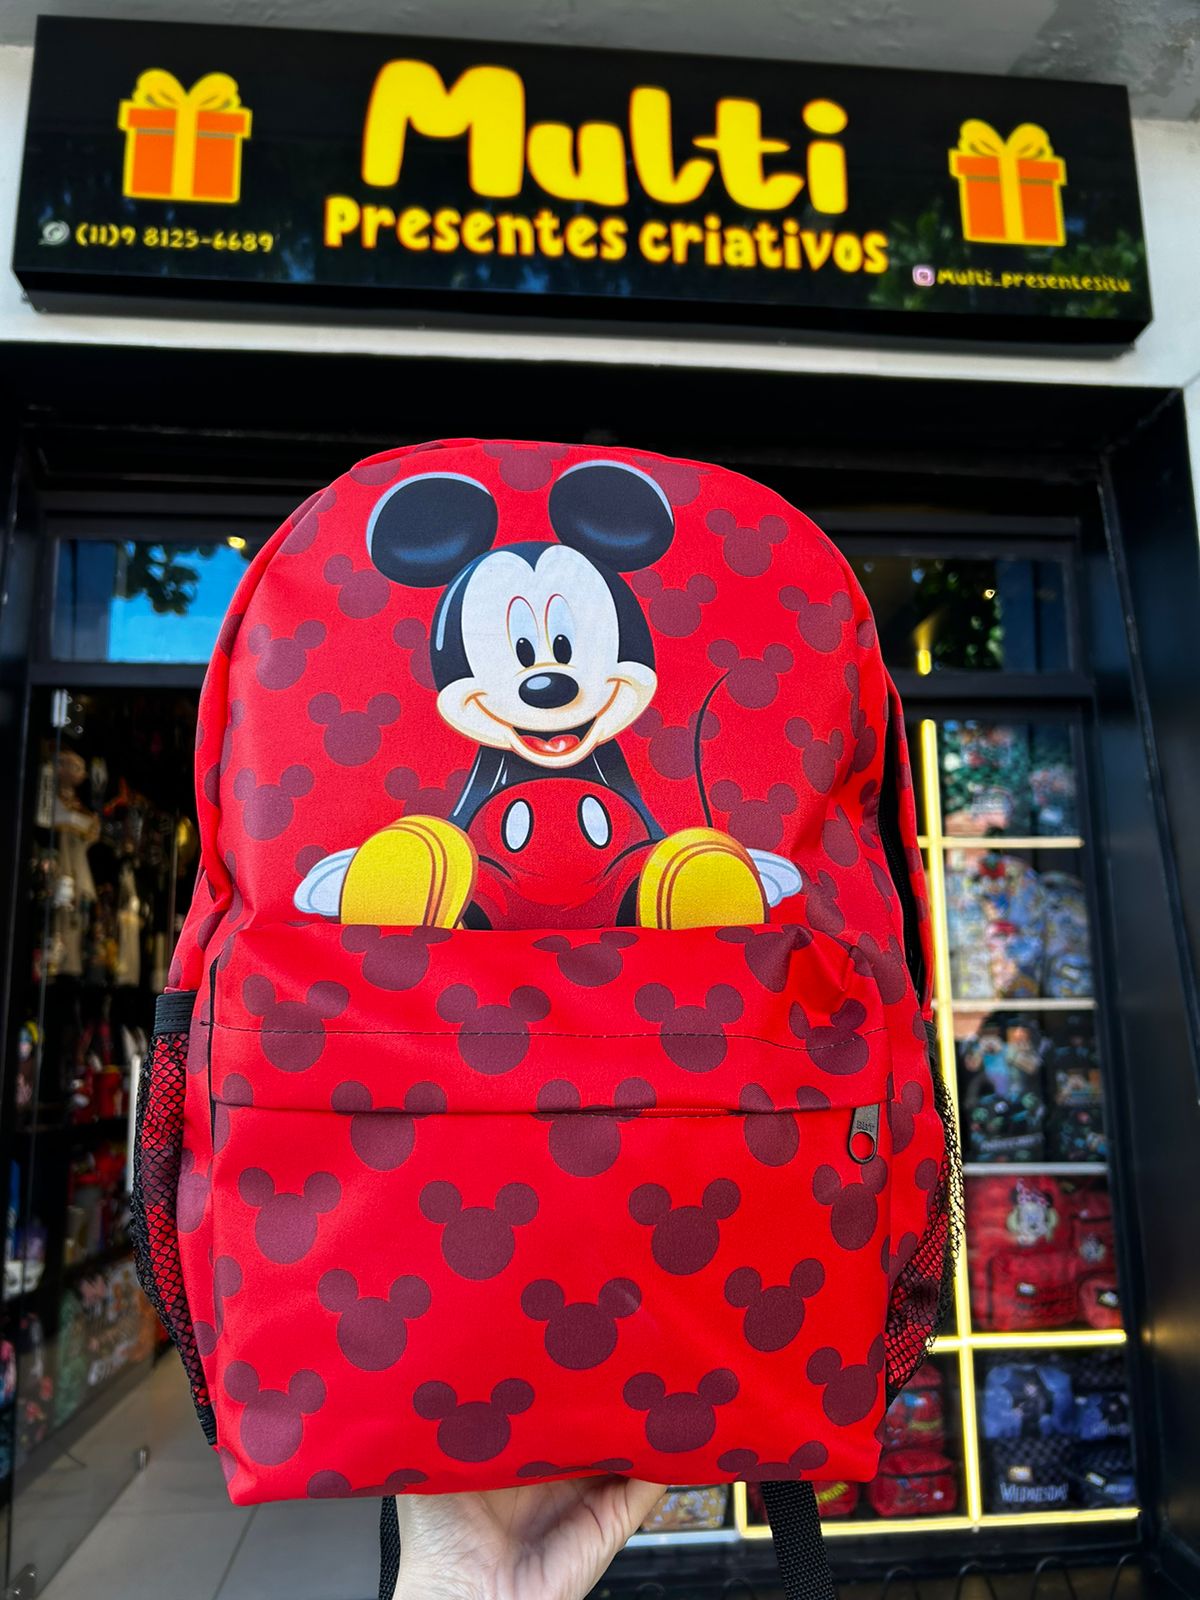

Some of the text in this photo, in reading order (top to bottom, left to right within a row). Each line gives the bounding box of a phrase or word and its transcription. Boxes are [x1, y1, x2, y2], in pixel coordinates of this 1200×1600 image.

[361, 58, 848, 215] Multi
[75, 223, 274, 253] (11)9 8125-6689
[638, 213, 889, 275] criativos
